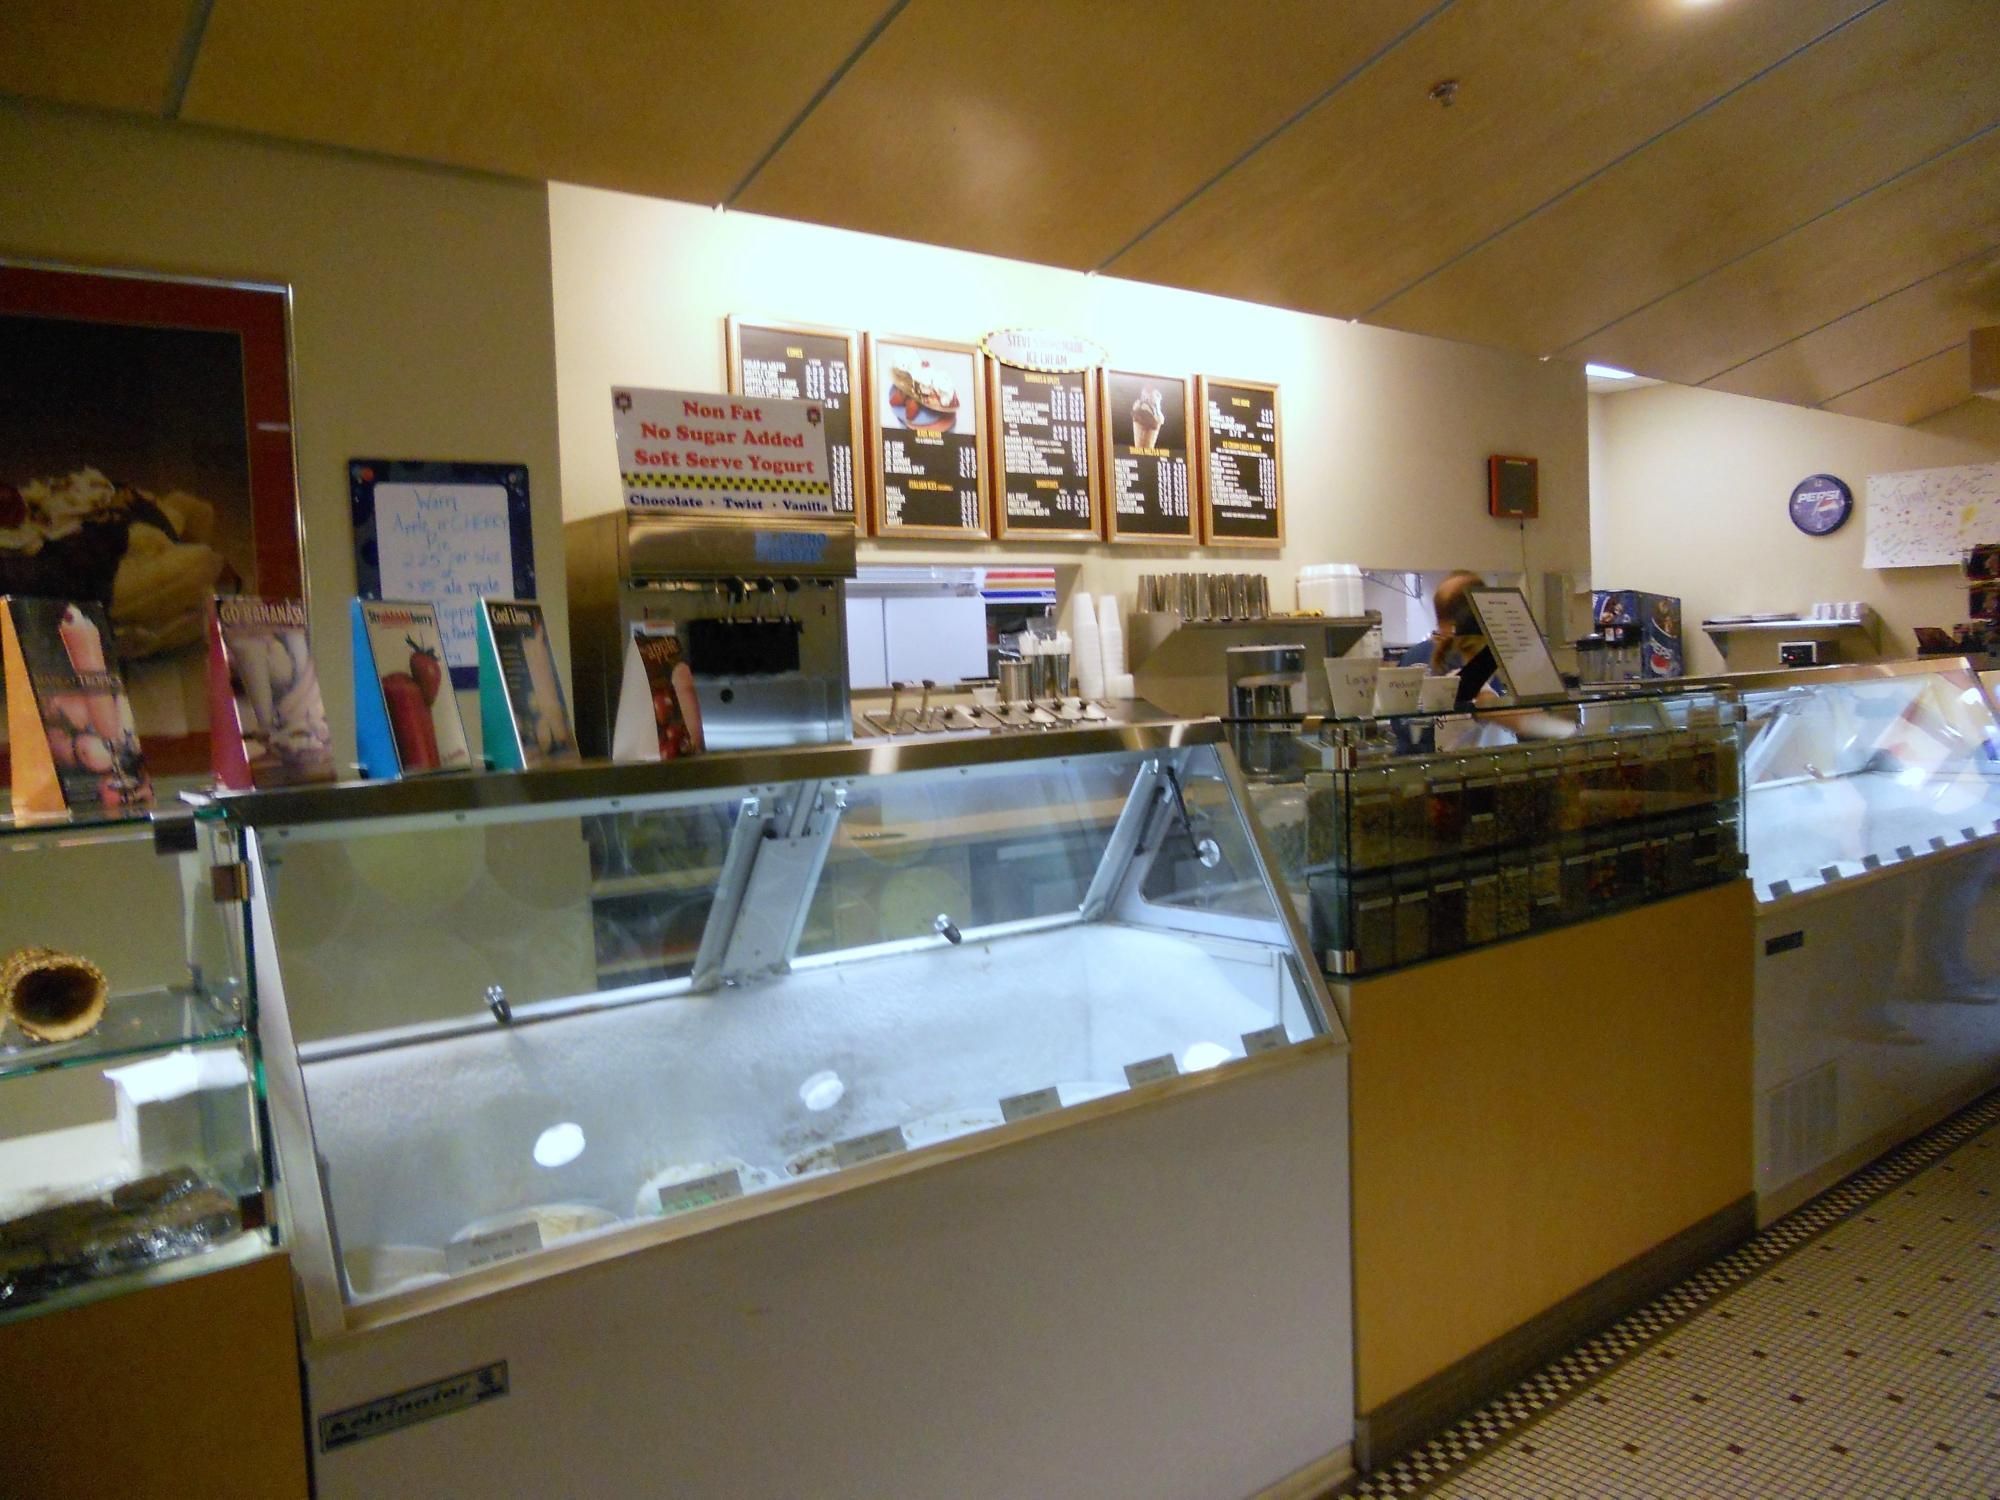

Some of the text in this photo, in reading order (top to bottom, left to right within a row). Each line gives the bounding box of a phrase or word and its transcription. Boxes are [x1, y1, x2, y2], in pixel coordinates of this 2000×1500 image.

[683, 400, 762, 422] Non Fat
[641, 422, 804, 448] No Sugar Added
[634, 449, 815, 476] Soft Serve Yogurt
[629, 495, 828, 513] Chocolate Twist Vanilla
[1797, 489, 1841, 504] PEPSI
